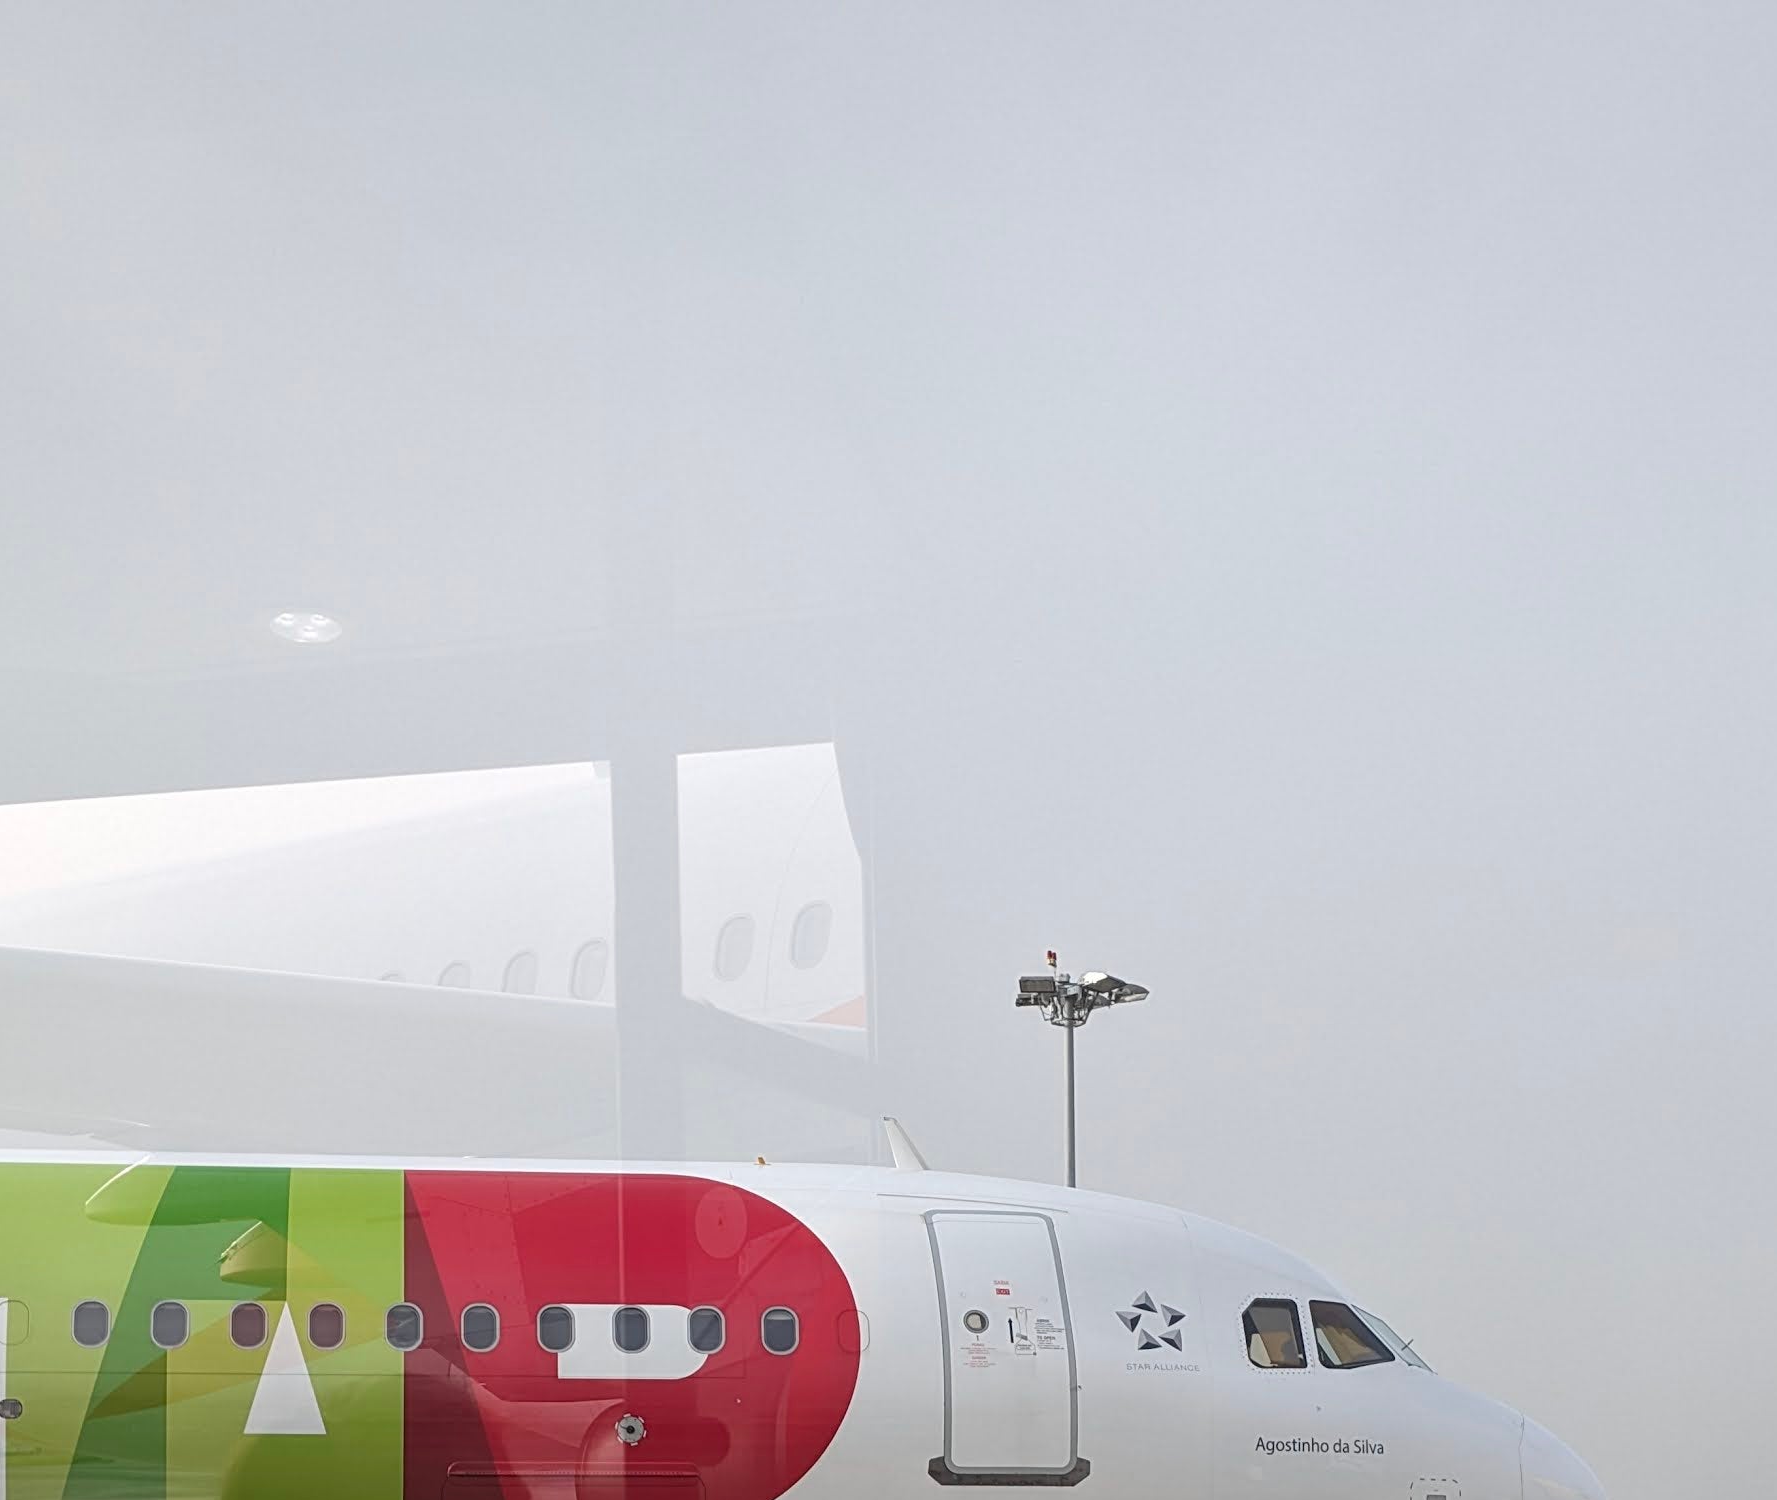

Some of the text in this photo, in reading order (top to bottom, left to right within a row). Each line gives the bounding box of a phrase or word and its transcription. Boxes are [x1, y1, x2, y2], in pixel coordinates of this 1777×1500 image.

[1255, 1437, 1384, 1455] Agostinho da Silva
